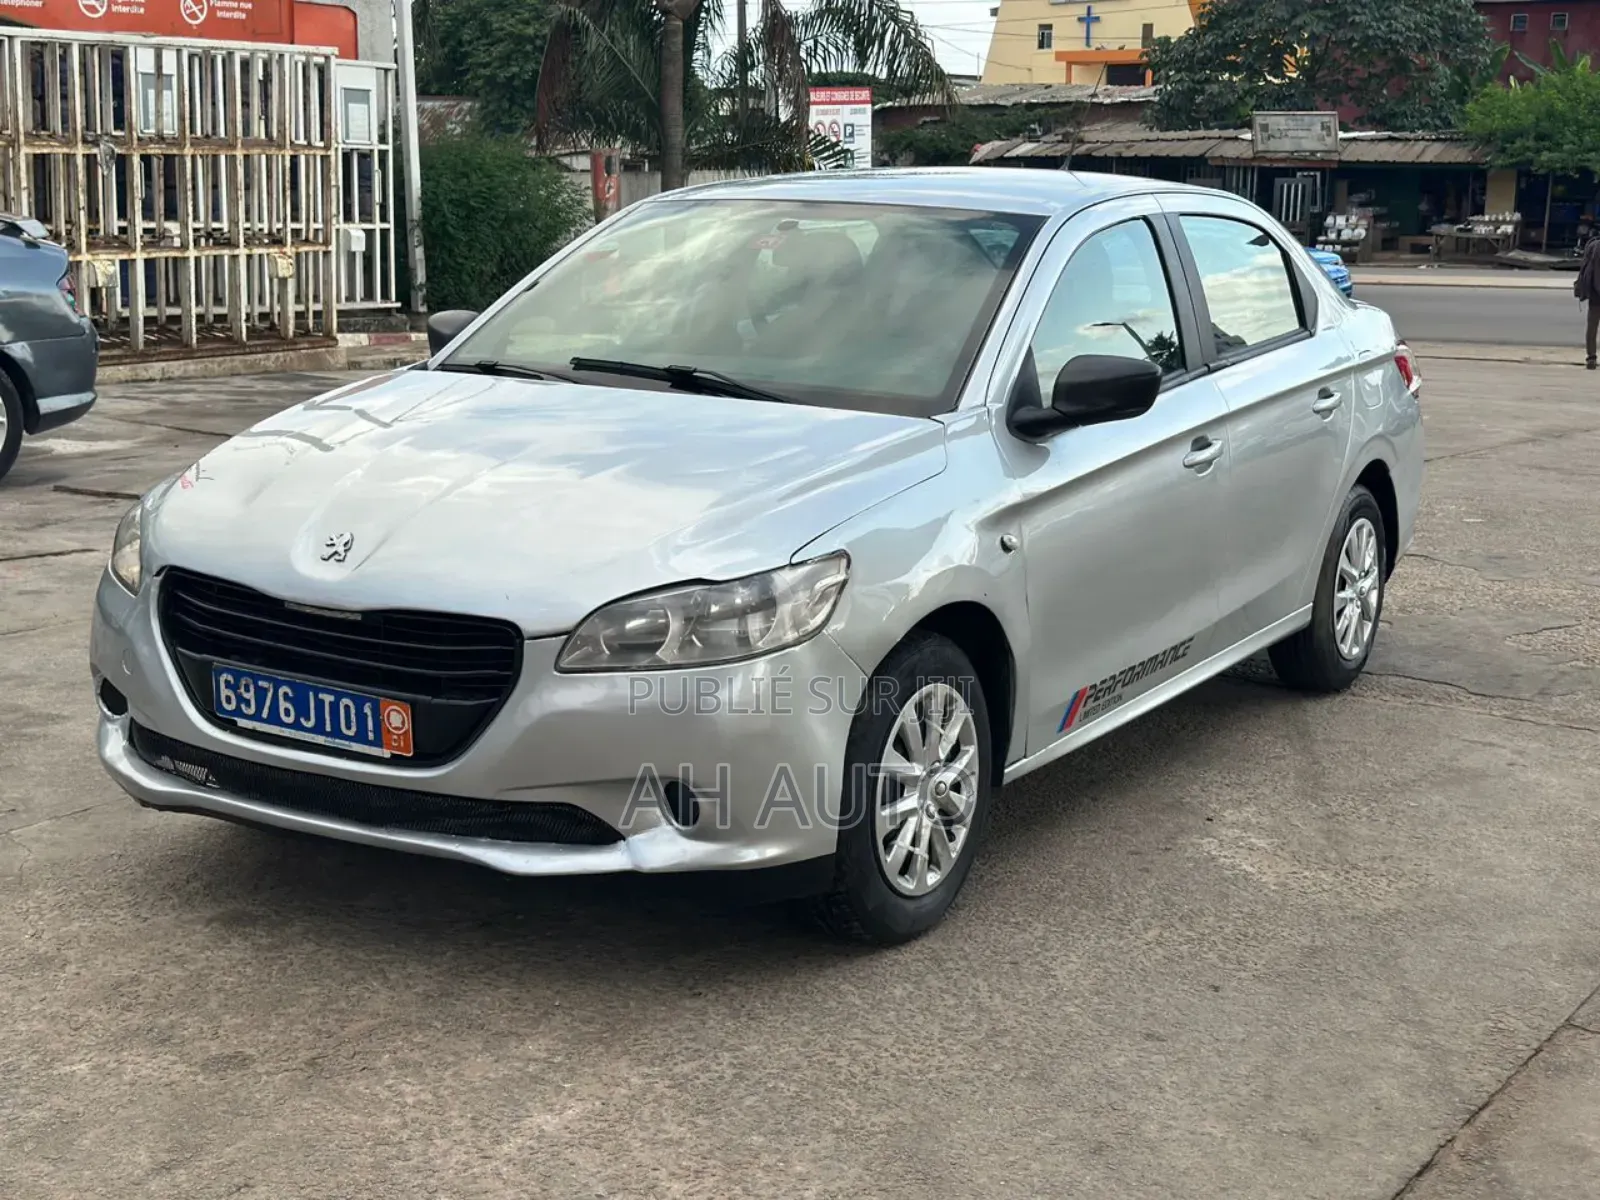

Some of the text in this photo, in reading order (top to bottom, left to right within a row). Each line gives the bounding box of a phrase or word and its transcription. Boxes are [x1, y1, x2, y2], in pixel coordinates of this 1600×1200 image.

[239, 2, 253, 10] nue
[845, 125, 853, 137] P
[1083, 635, 1195, 707] PERFORMANCE
